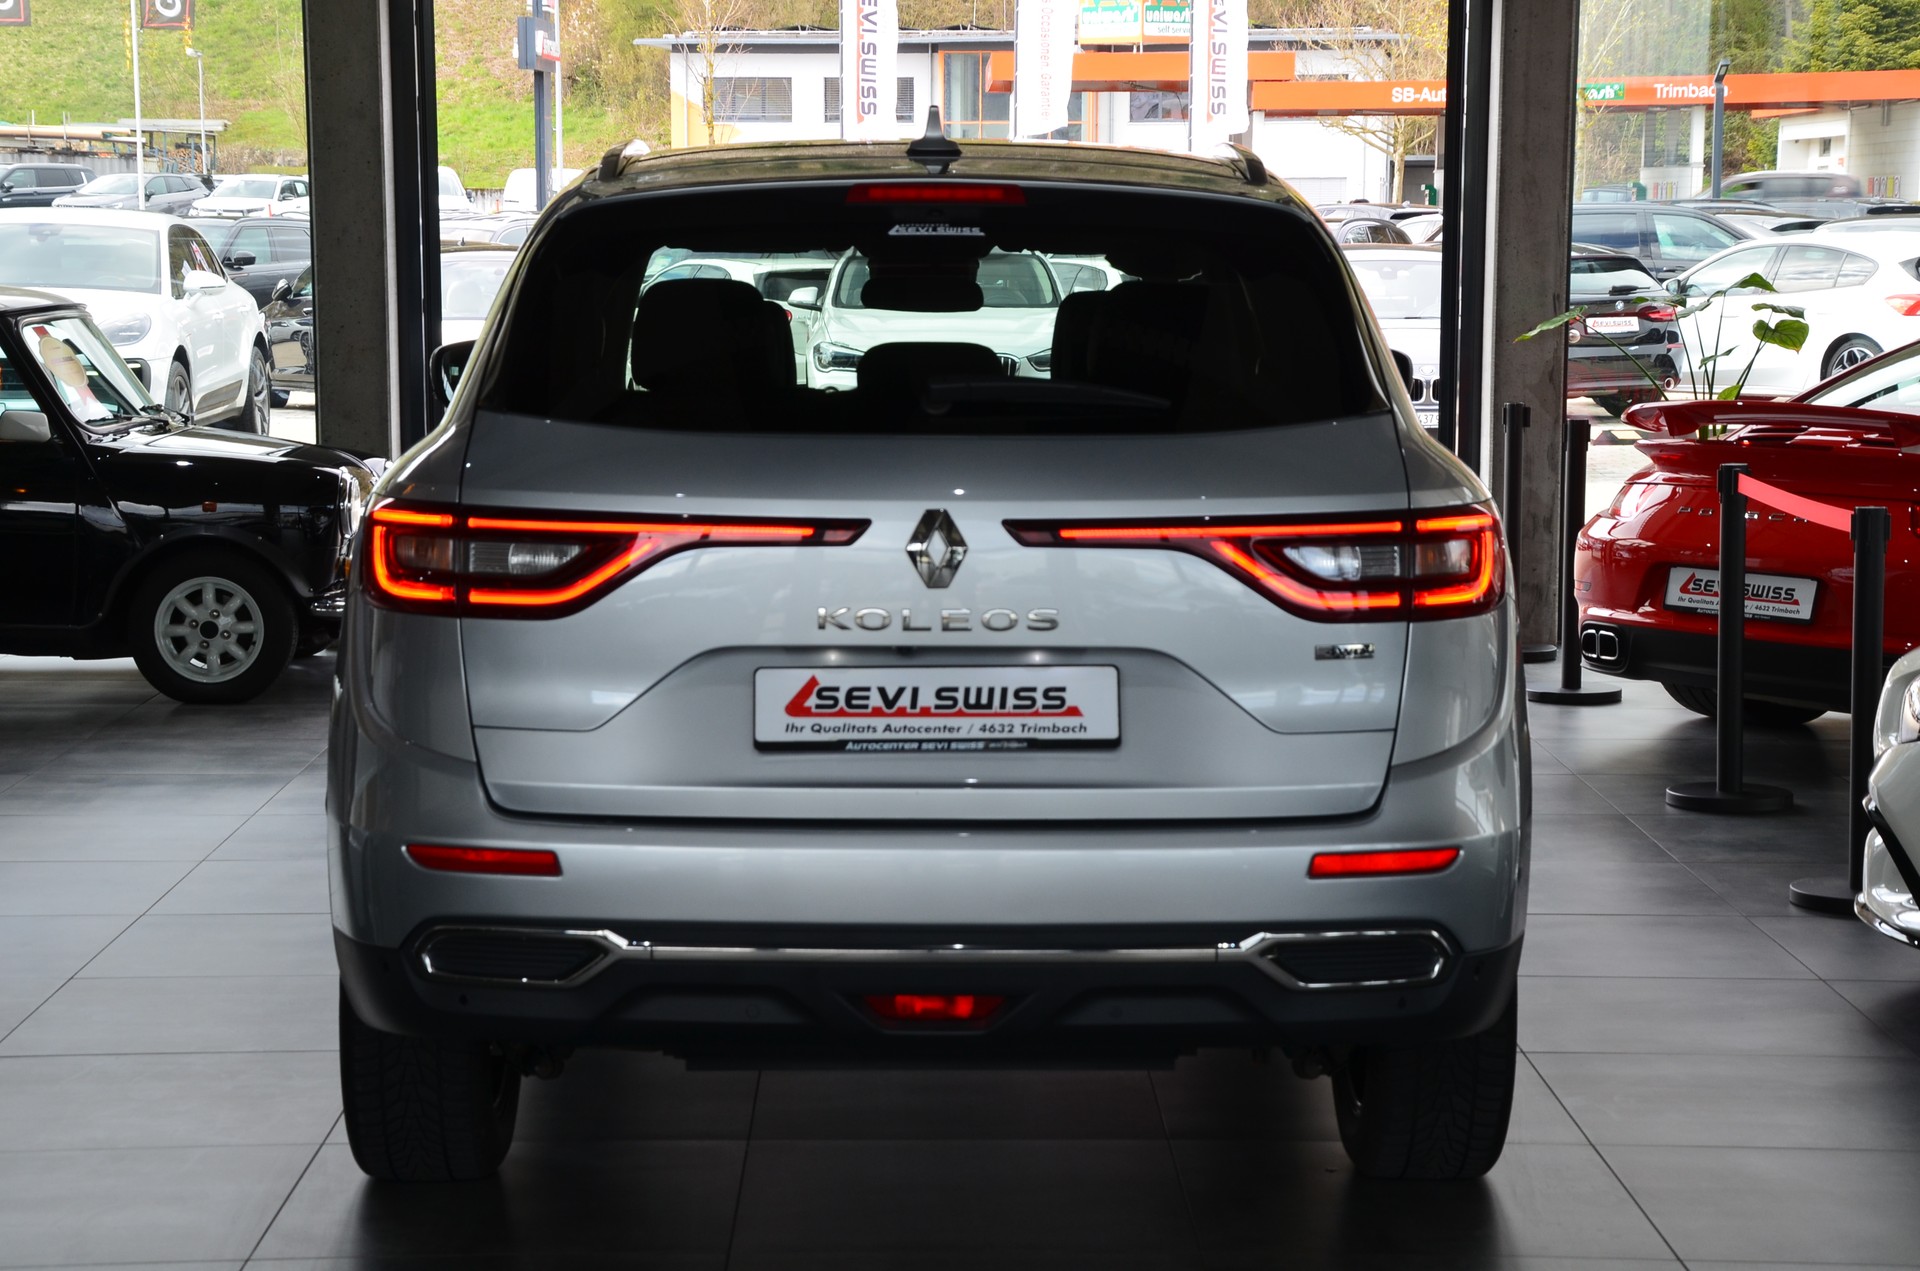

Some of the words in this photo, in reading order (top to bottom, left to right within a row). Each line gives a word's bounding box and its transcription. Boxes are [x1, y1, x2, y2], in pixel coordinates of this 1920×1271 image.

[861, 41, 877, 115] SWISS
[1211, 41, 1227, 115] SWISS
[817, 607, 1060, 632] KOLEOS
[814, 686, 920, 710] SEVI
[934, 686, 1067, 710] SWISS
[785, 723, 805, 733] Ihr
[811, 723, 877, 734] Qualitats
[882, 723, 962, 734] Autocenter
[978, 723, 1015, 734] 4632
[1020, 723, 1087, 734] Trimbach
